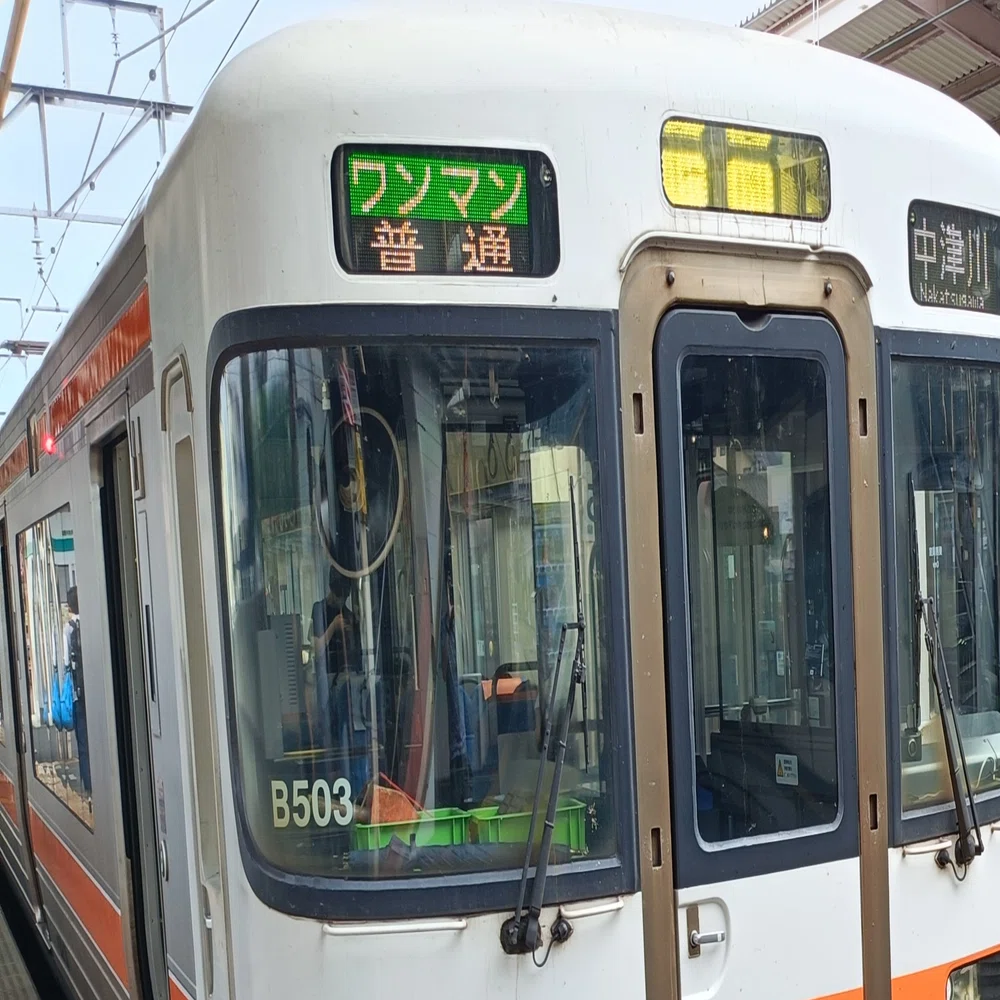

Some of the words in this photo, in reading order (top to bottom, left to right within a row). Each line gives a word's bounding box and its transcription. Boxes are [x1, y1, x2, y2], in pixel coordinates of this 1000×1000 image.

[352, 160, 522, 220] ワンマン
[370, 219, 514, 272] 普通
[914, 217, 988, 289] 中津川
[271, 777, 353, 828] B503
